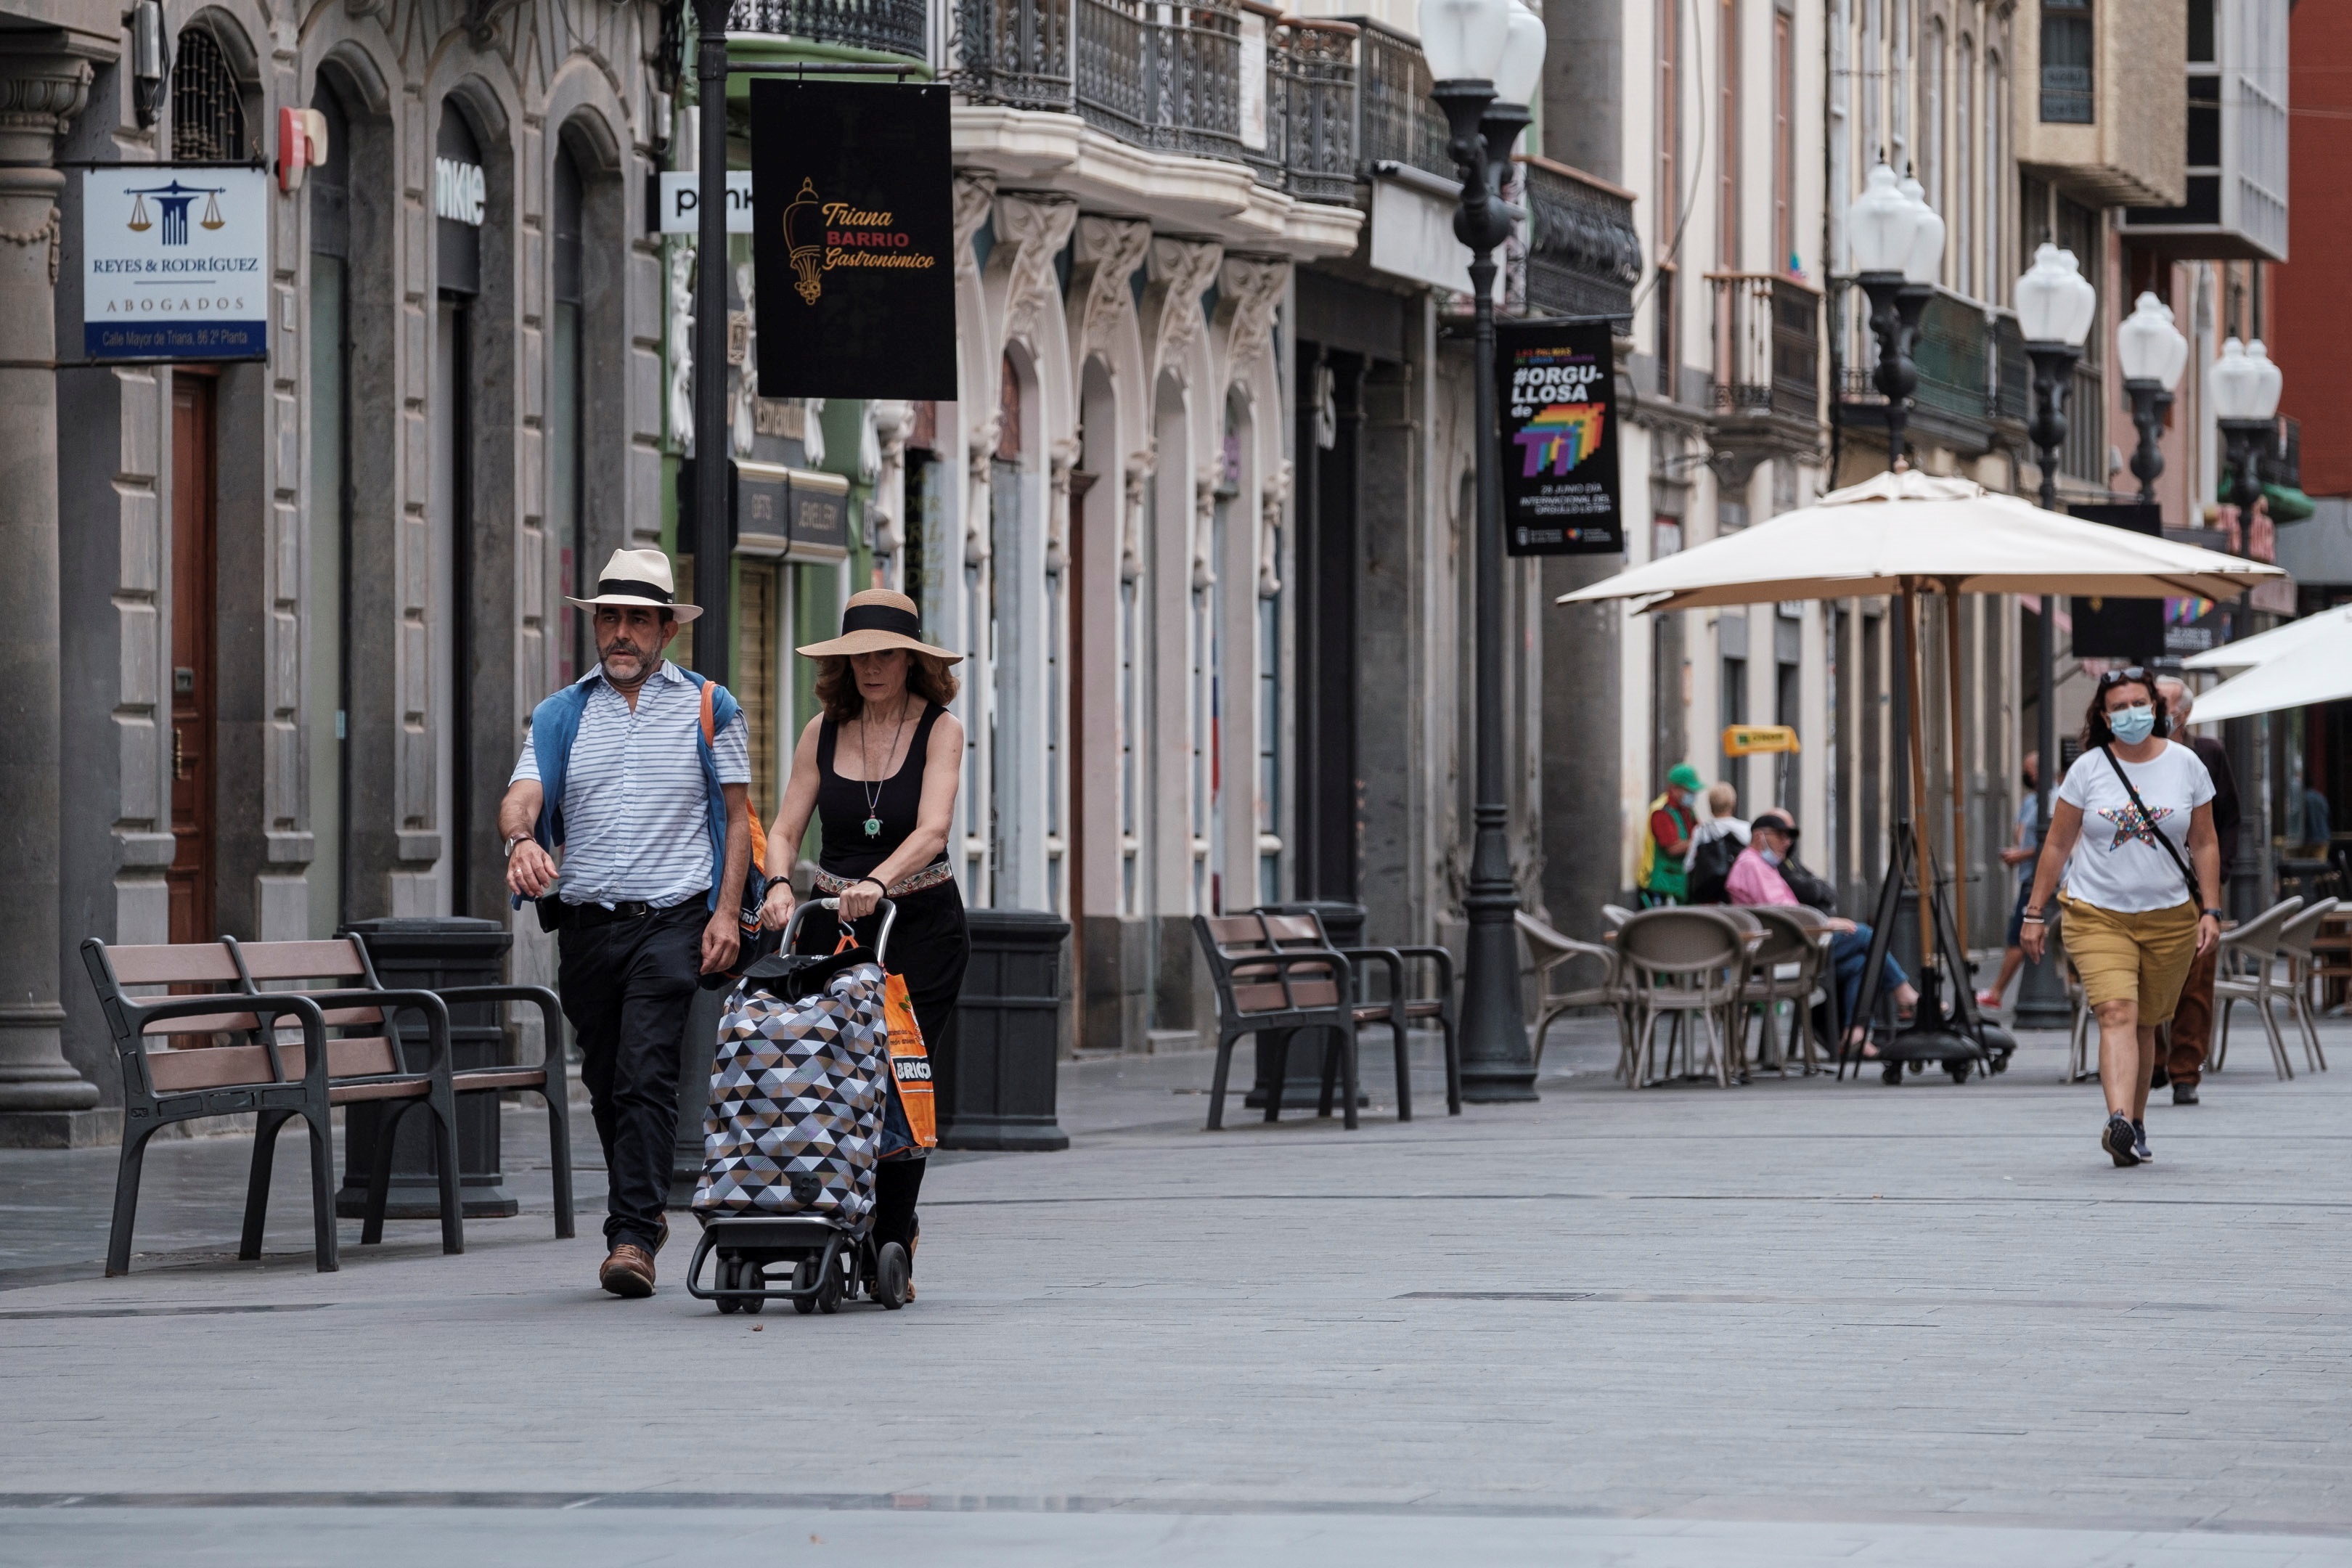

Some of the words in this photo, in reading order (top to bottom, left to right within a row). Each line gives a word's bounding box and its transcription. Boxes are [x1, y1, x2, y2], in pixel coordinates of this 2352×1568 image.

[822, 203, 893, 226] Triana
[827, 231, 909, 247] BARRIO
[93, 258, 142, 273] REYES
[145, 258, 157, 272] &
[161, 256, 258, 272] RODRÍGUEZ
[822, 247, 934, 270] Gastronómico
[107, 297, 244, 312] ABOGADOS
[102, 331, 124, 346] Calle
[126, 331, 151, 349] Mayor
[154, 330, 164, 345] de
[197, 330, 208, 345] 86
[221, 329, 248, 344] Planta
[1513, 365, 1604, 386] #ORGU-
[1511, 383, 1588, 404] LLOSA
[1511, 404, 1532, 417] de
[1555, 483, 1584, 494] JUNIO
